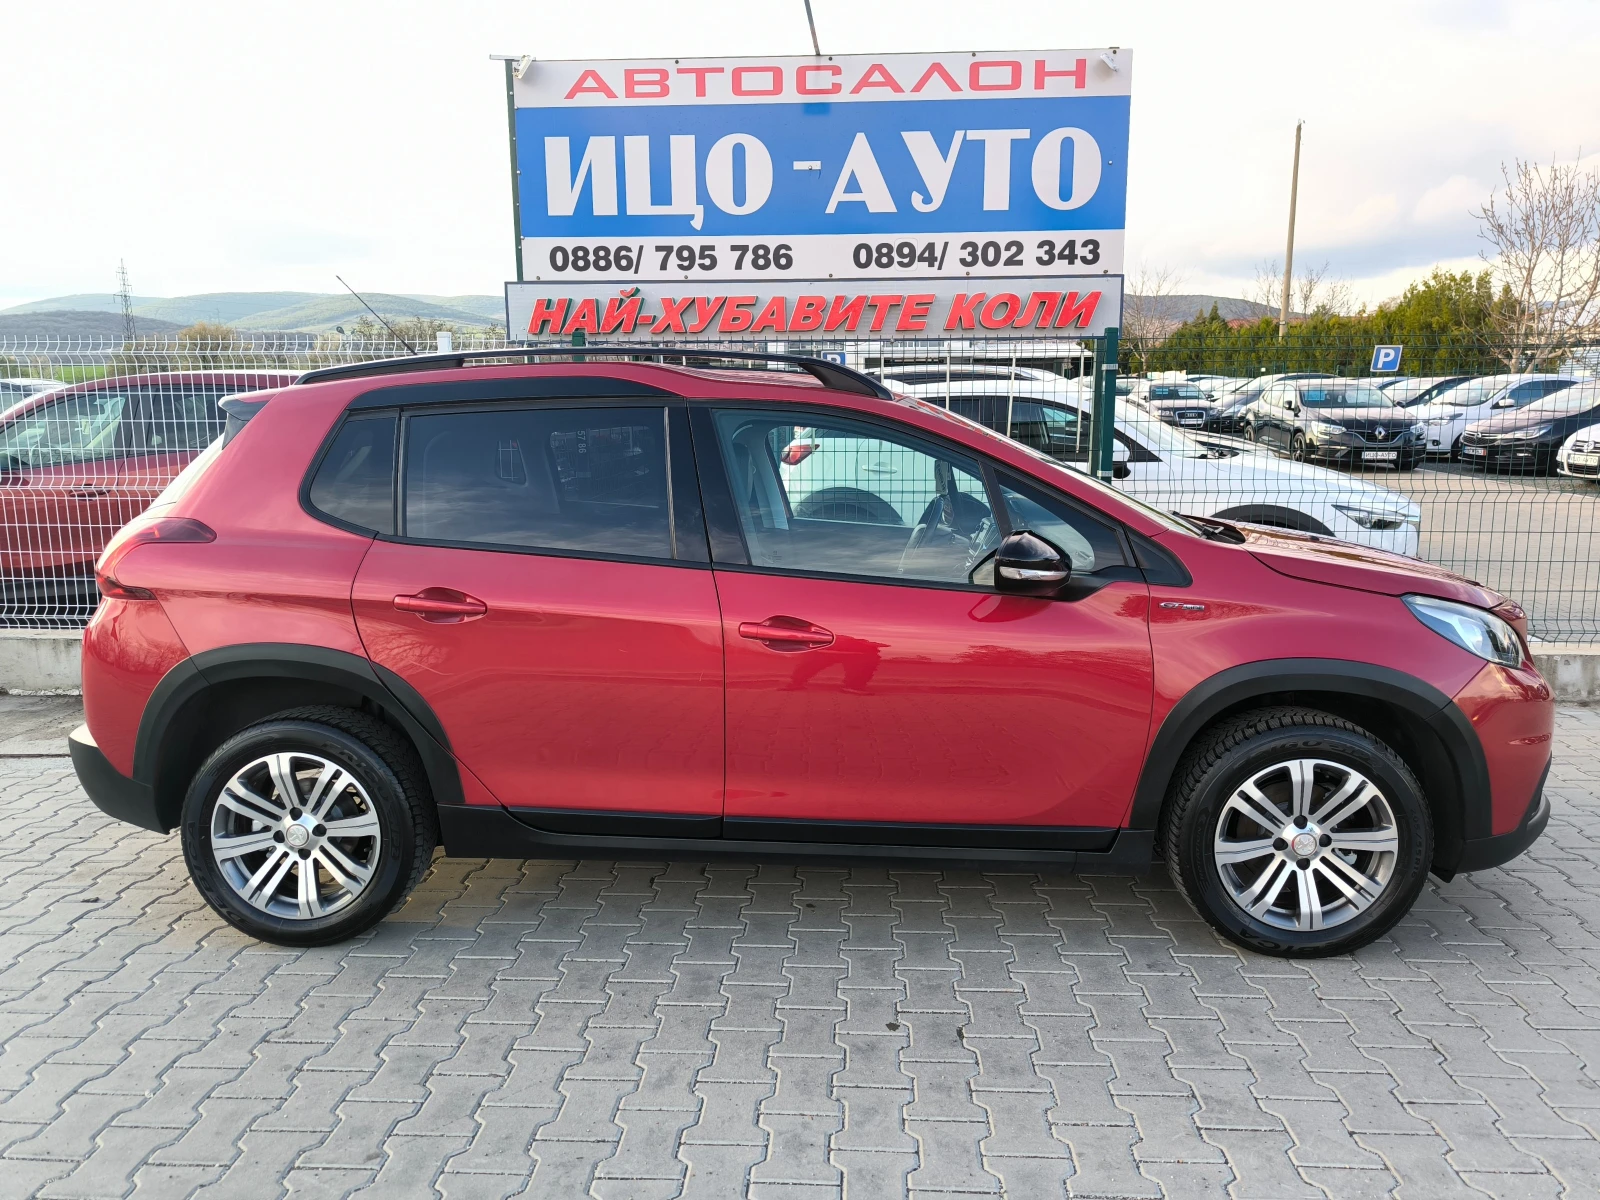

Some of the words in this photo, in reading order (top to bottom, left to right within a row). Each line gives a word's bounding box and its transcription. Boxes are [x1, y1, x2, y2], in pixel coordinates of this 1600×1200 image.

[564, 59, 1087, 100] АВТОСАЛОН
[549, 245, 644, 272] 0886/
[655, 245, 718, 271] 795
[730, 244, 793, 271] 786
[853, 242, 949, 271] 0894/
[960, 241, 1024, 267] 302
[1036, 239, 1101, 266] 343
[527, 287, 936, 335] НАЙ-ХУБАВИТЕ
[945, 290, 1103, 330] КОЛИ
[1377, 349, 1395, 368] P
